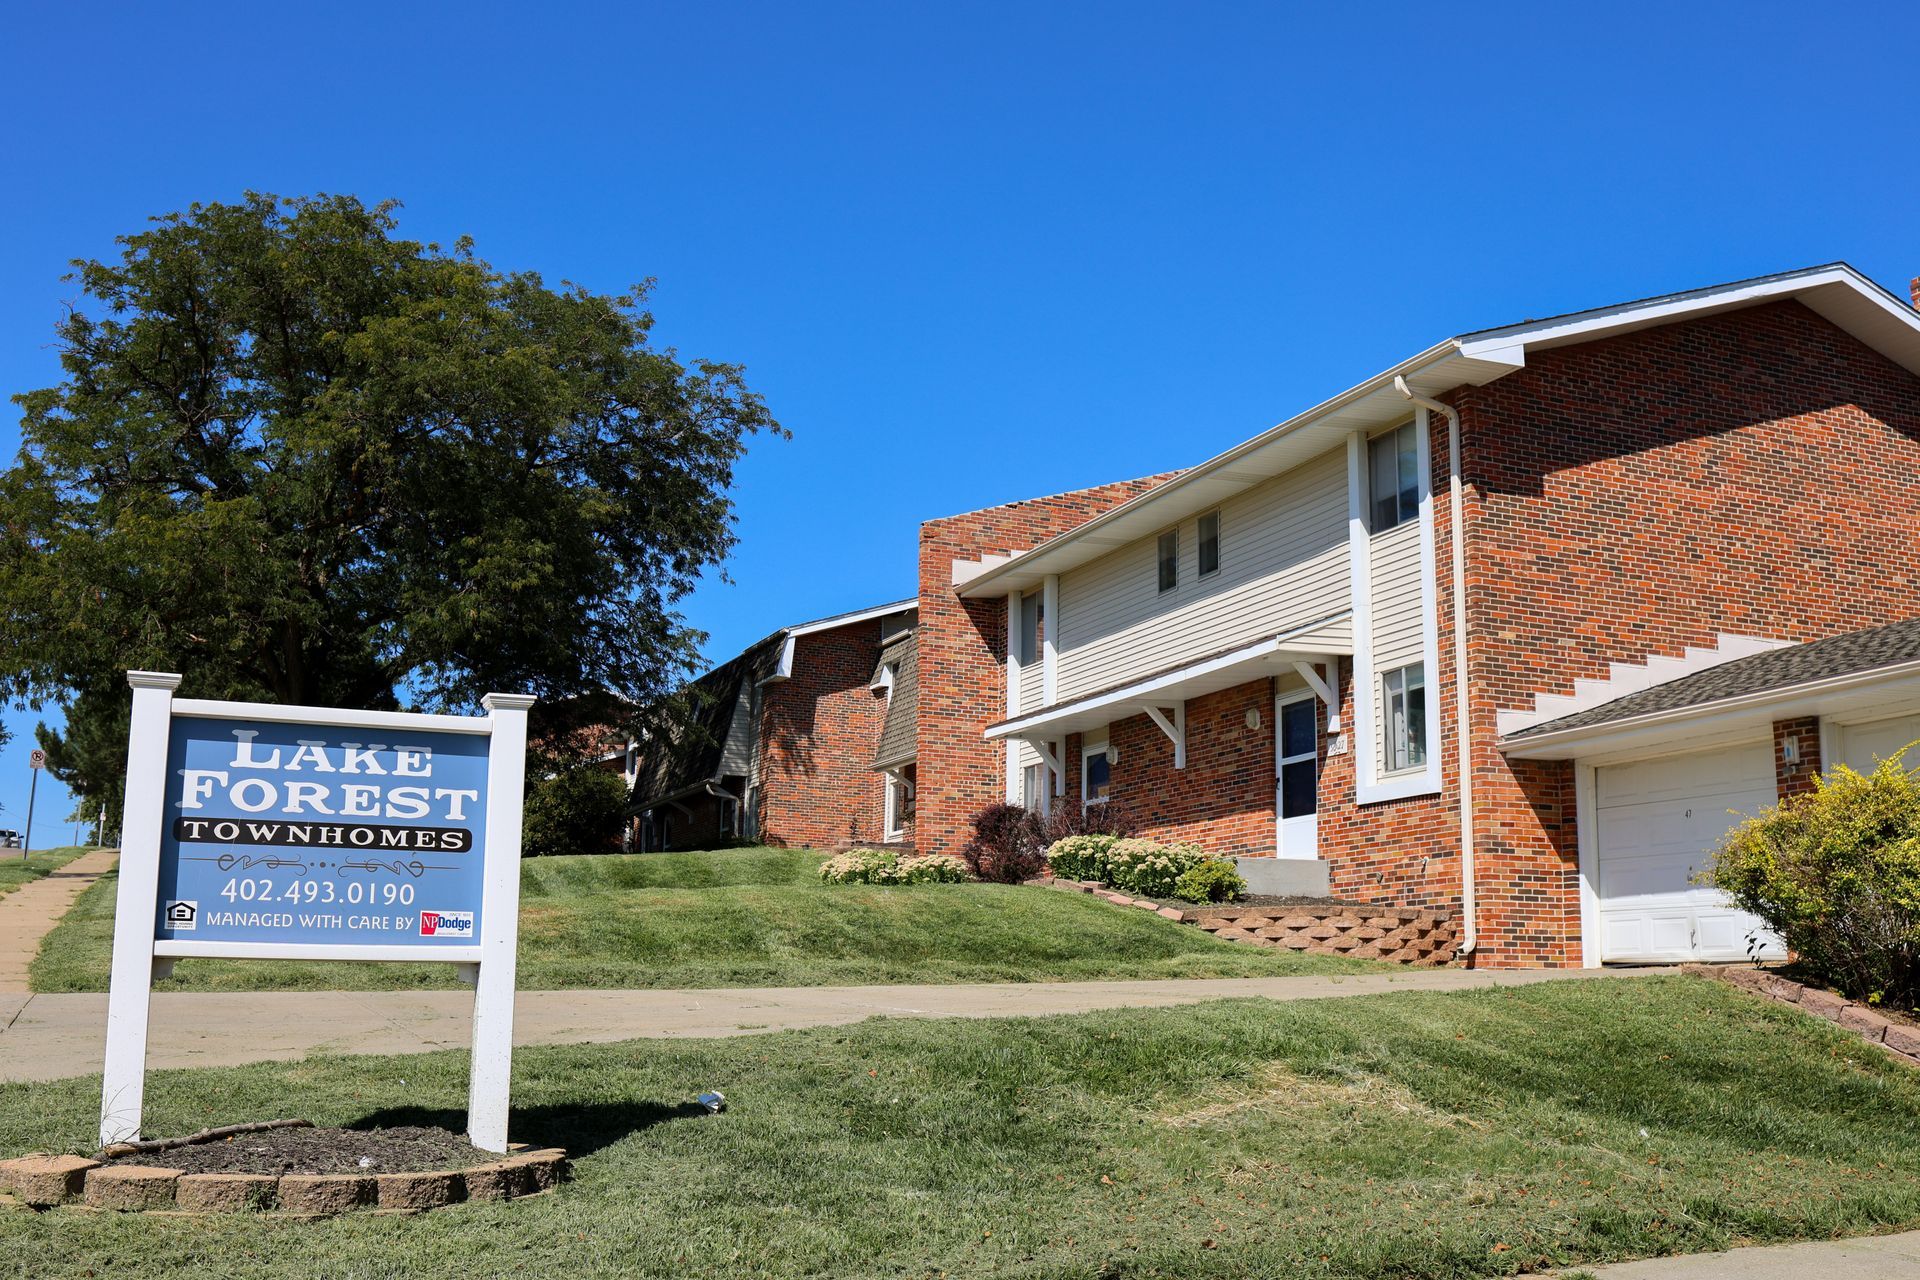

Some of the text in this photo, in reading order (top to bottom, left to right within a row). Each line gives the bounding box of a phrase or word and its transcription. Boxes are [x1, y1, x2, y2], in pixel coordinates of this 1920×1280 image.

[229, 729, 432, 777] LAKE
[174, 769, 478, 820] FOREST
[1685, 809, 1692, 819] 47
[183, 820, 464, 849] TOWNHOMES
[220, 878, 415, 906] 402.493.0190
[206, 911, 414, 930] MANAGED WITH CARE BY
[422, 914, 472, 931] NP Dodge
